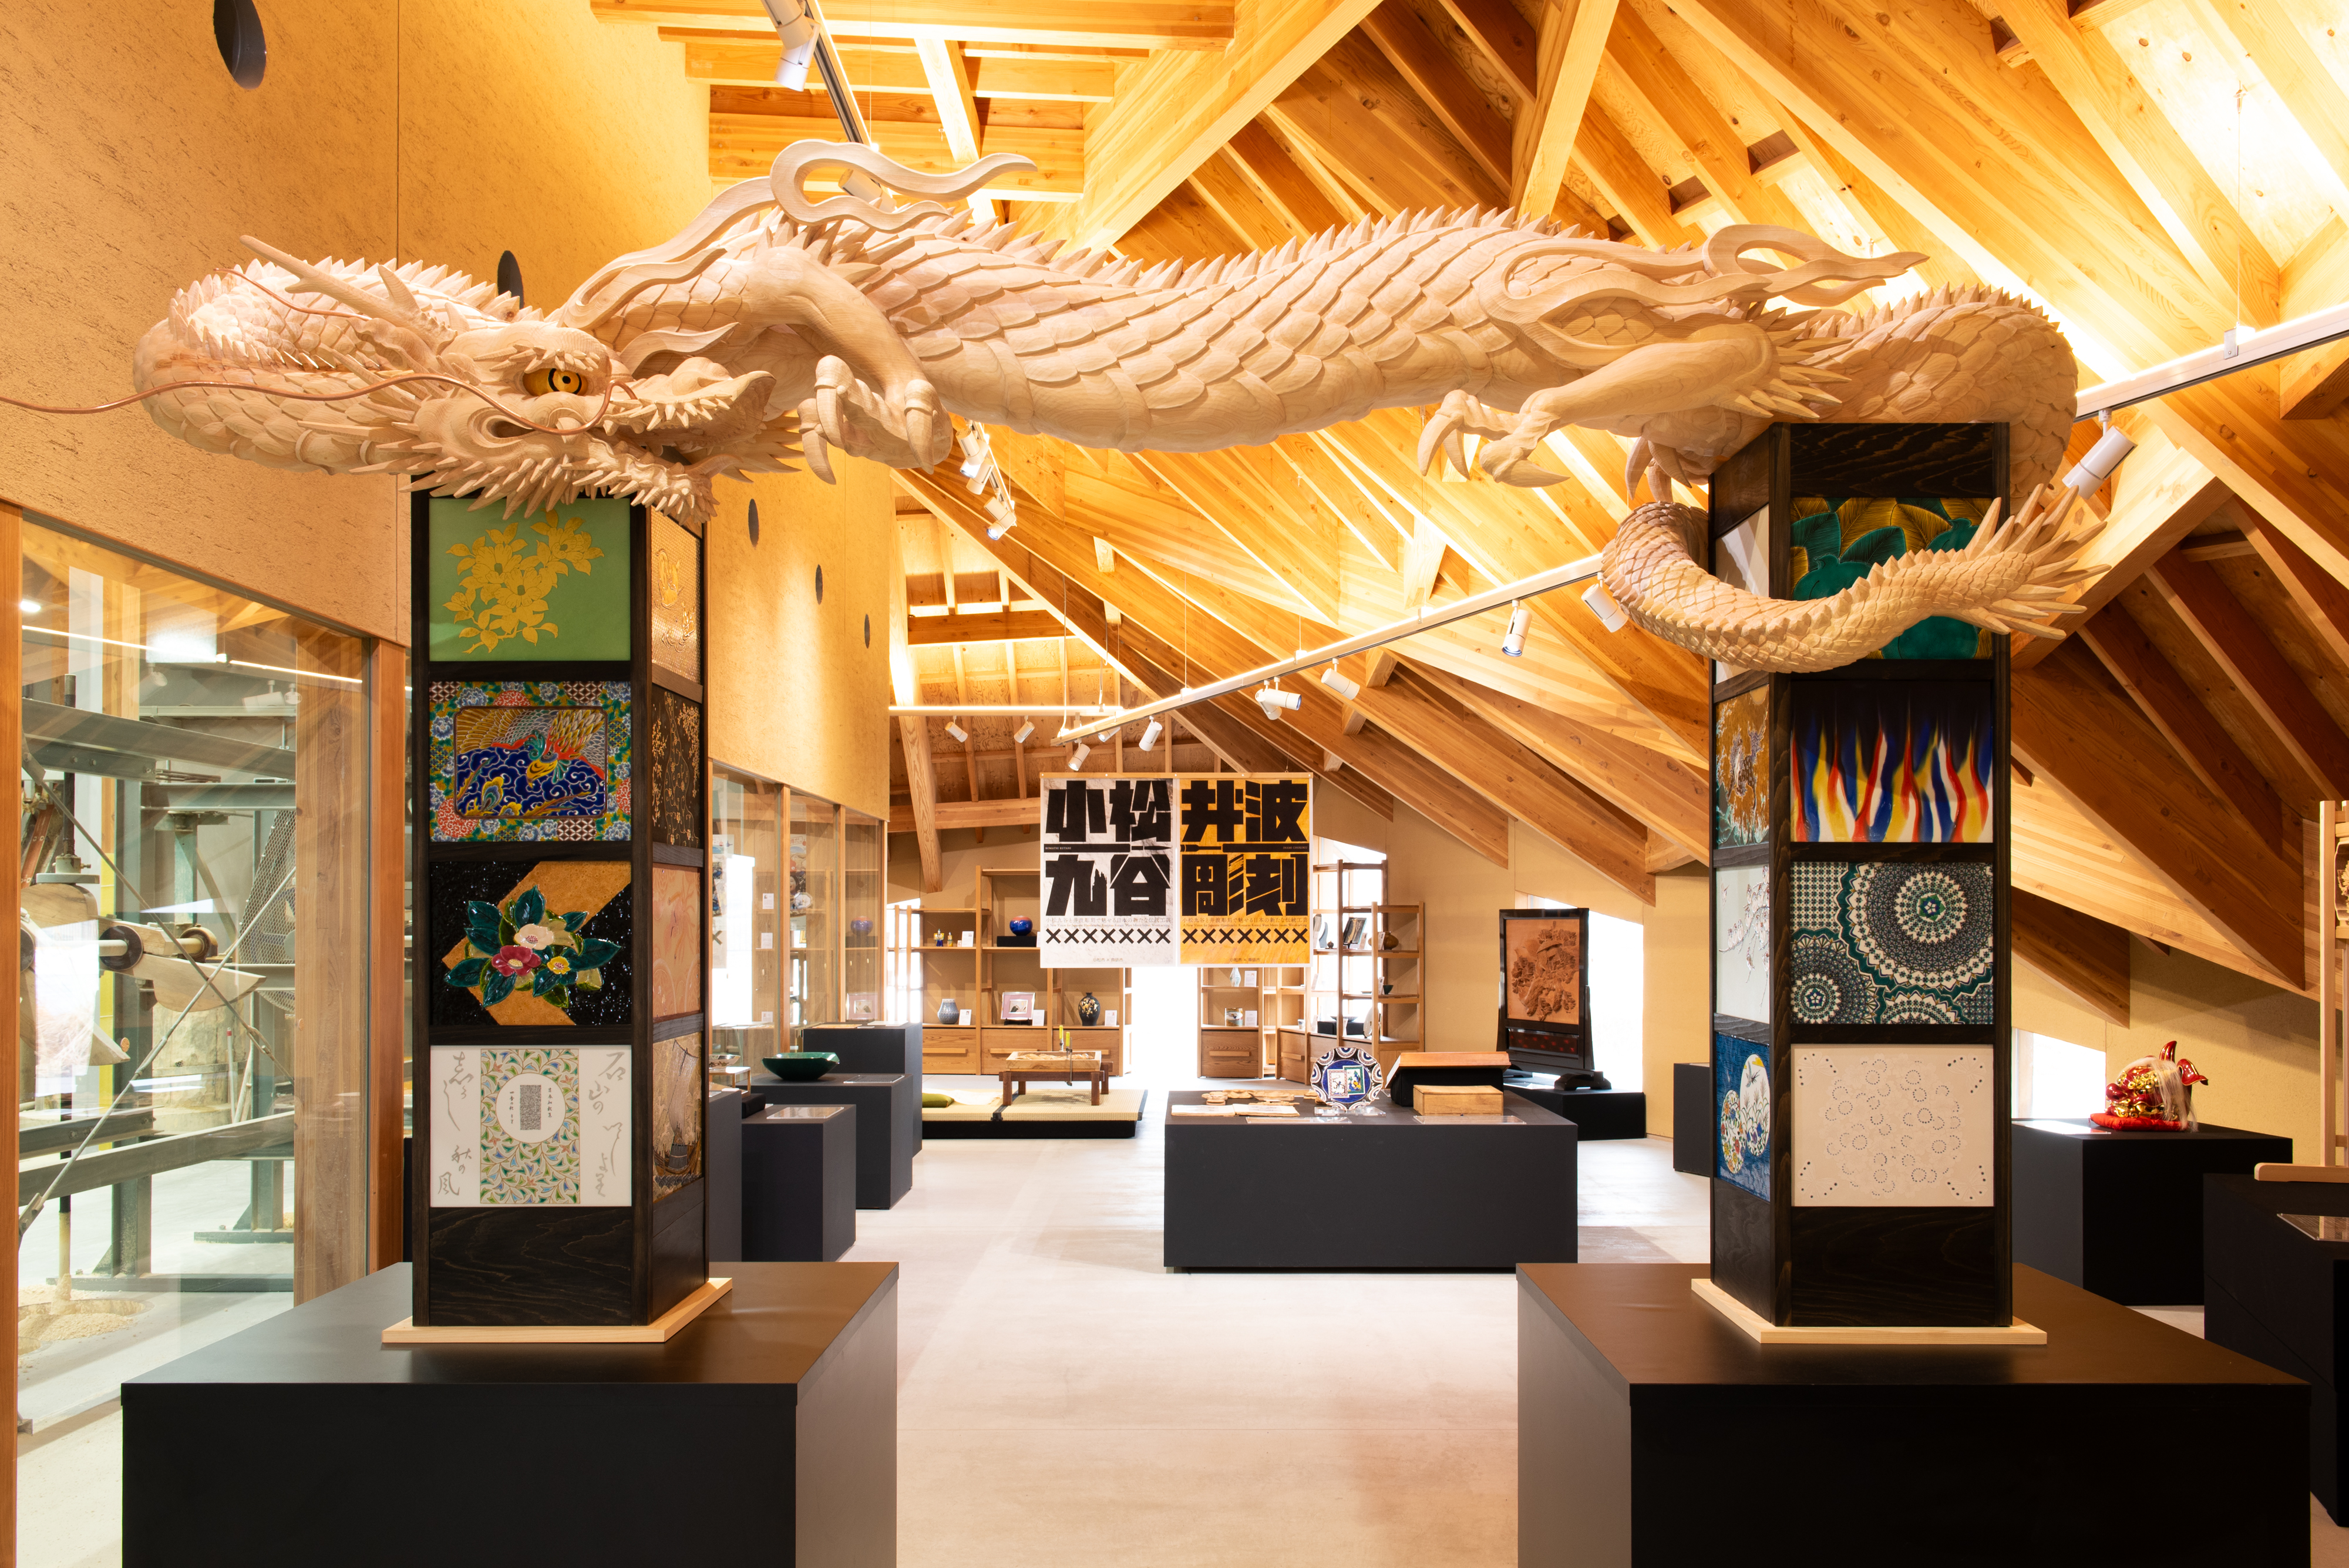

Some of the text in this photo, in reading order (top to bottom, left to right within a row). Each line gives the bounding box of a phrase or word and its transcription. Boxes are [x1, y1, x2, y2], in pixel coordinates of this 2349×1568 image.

[1045, 780, 1171, 842] 小松
[1181, 780, 1308, 842] 井波
[1045, 854, 1171, 916] 九谷
[1181, 854, 1308, 916] 彫刻
